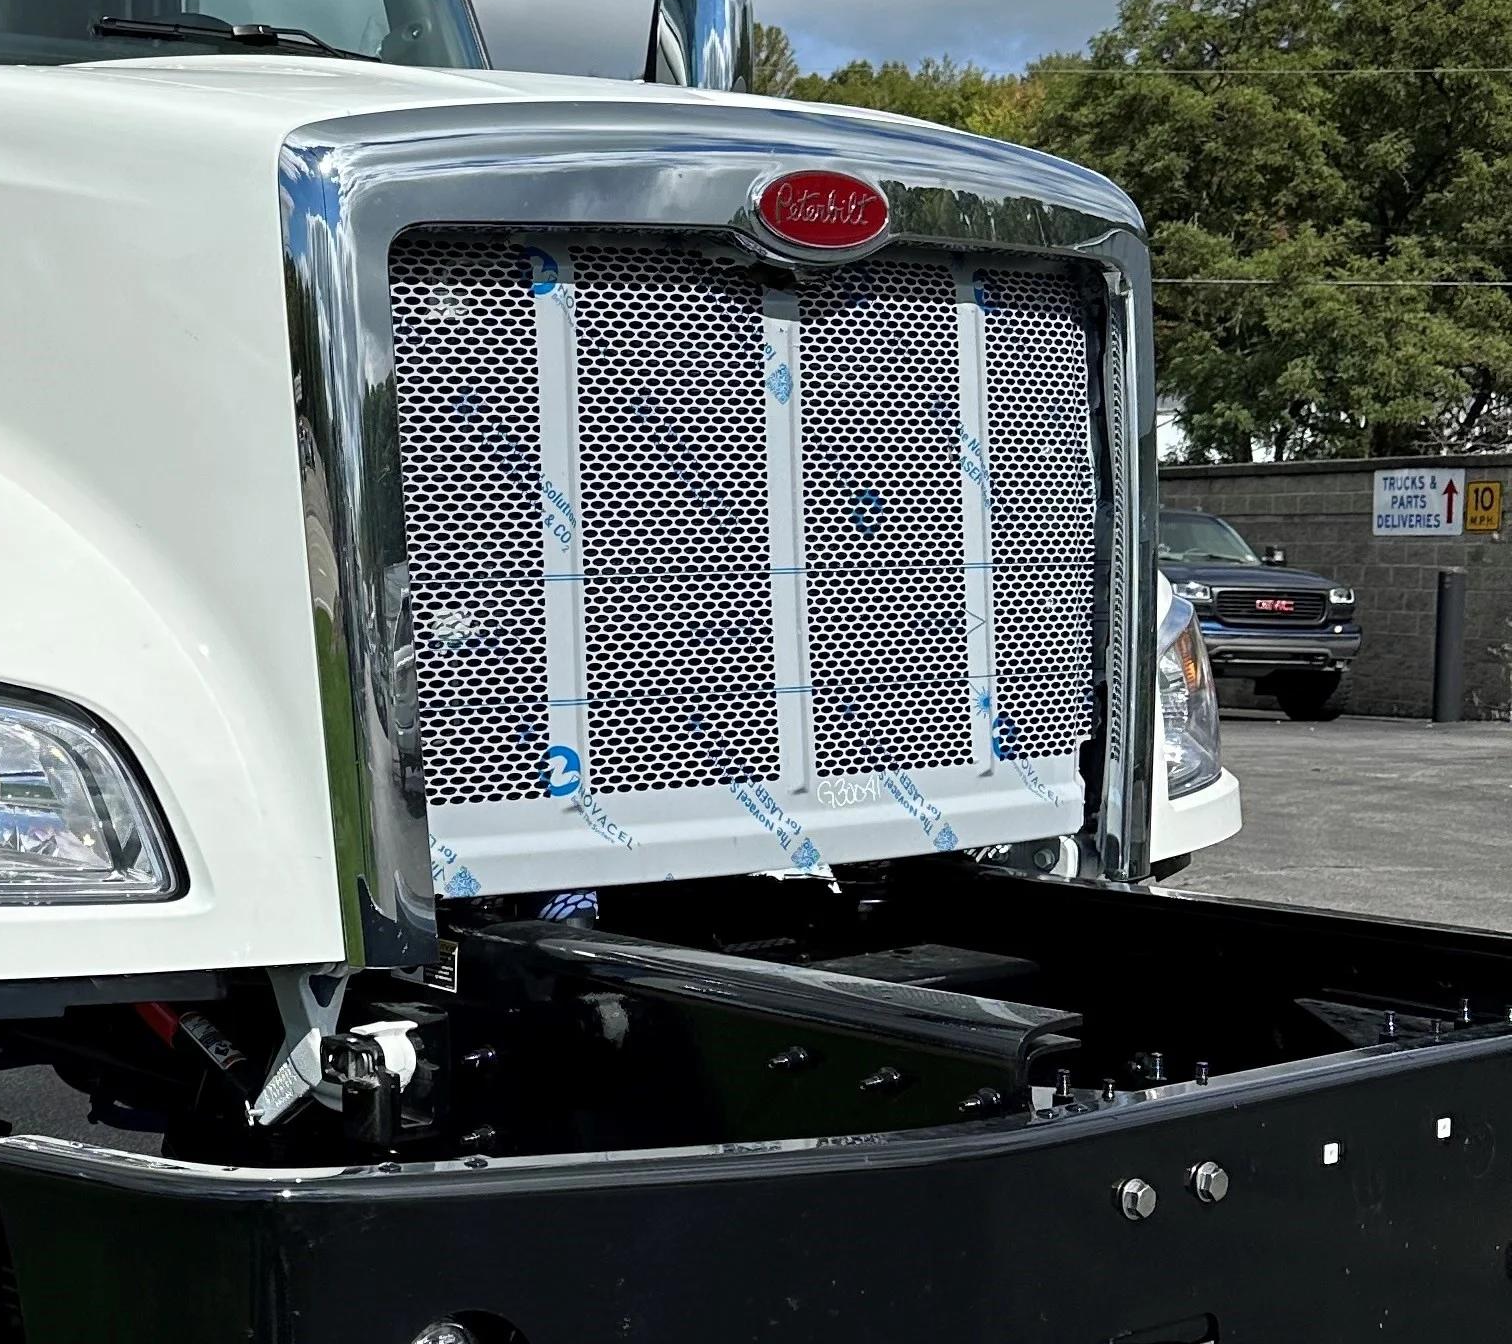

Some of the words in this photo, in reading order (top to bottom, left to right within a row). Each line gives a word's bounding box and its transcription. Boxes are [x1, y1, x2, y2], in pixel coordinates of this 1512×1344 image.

[775, 182, 878, 224] Peterbilt
[1382, 476, 1425, 491] TRUCKS
[1429, 476, 1437, 489] &
[542, 480, 576, 528] Solution
[1391, 494, 1427, 509] PARTS
[1474, 486, 1494, 512] 10
[544, 513, 555, 528] &
[1377, 514, 1440, 529] DELIVERIES
[899, 772, 925, 807] LASER
[1022, 758, 1059, 807] OVACEL
[755, 784, 784, 821] LASER
[884, 777, 918, 816] Novacel
[577, 782, 633, 851] NOVACEL
[736, 790, 775, 831] Novacel
[926, 804, 942, 821] for
[786, 817, 802, 836] for
[919, 813, 934, 836] The
[776, 826, 792, 851] The
[438, 845, 458, 865] for
